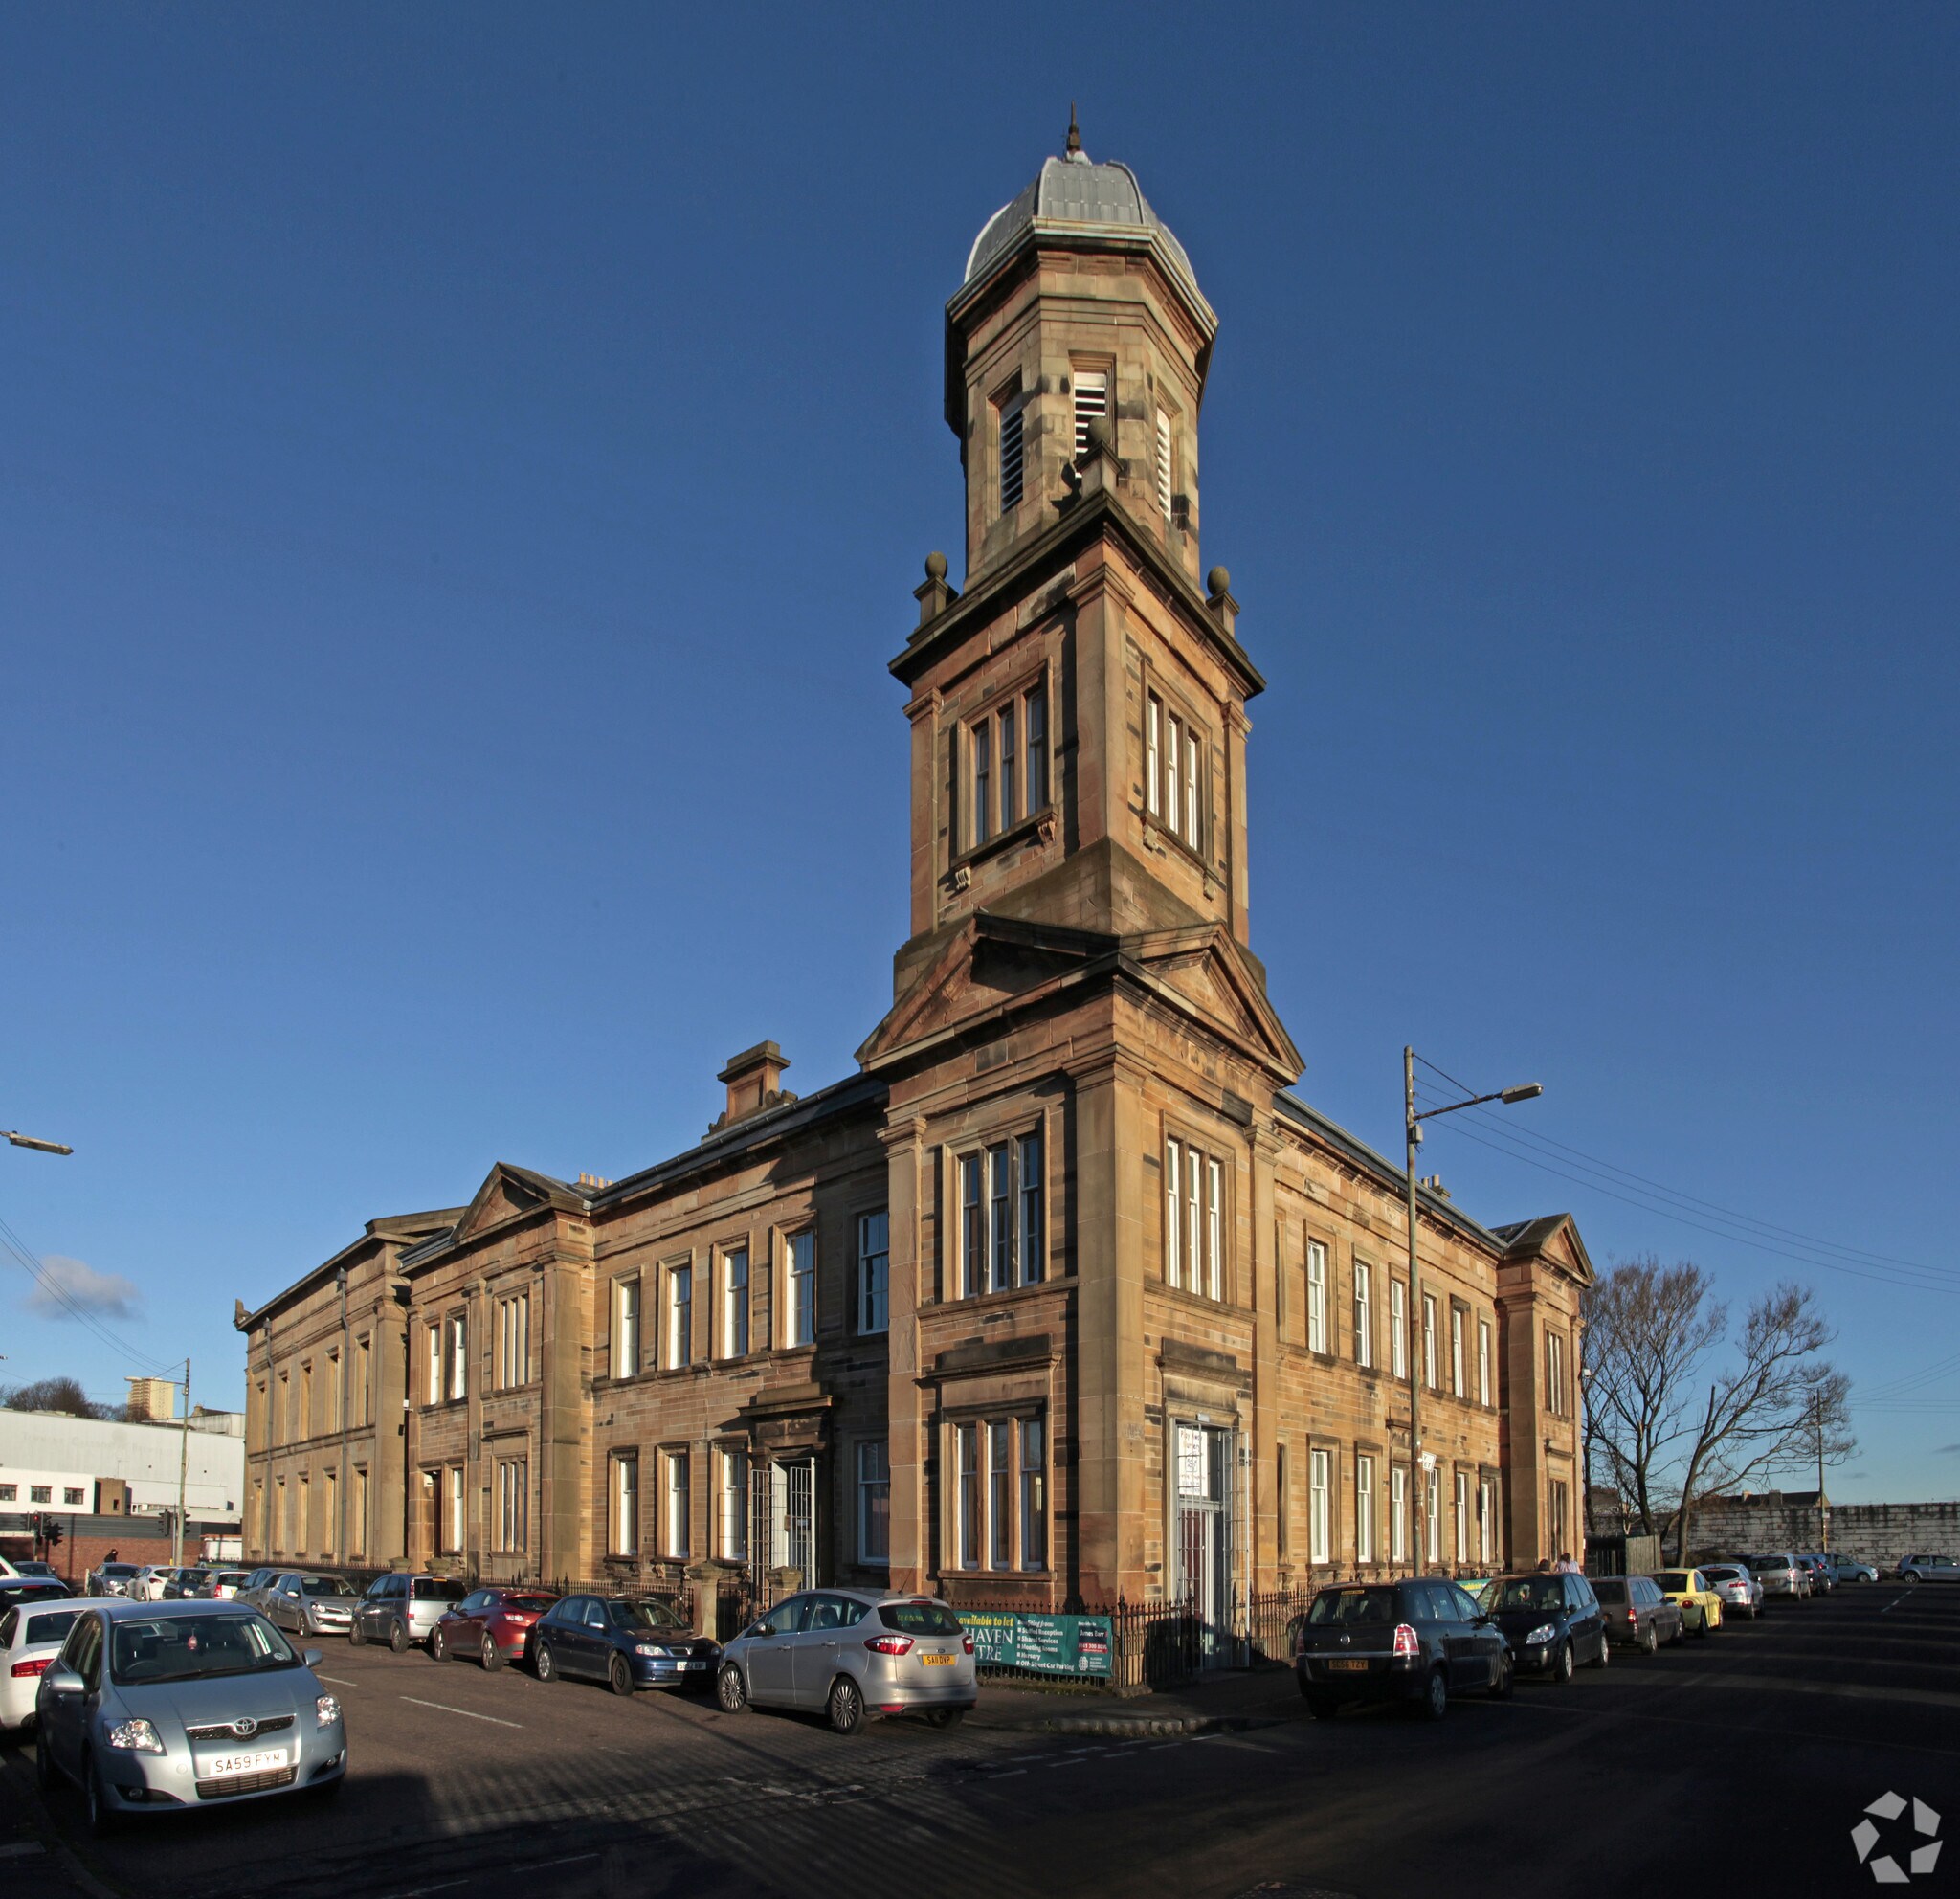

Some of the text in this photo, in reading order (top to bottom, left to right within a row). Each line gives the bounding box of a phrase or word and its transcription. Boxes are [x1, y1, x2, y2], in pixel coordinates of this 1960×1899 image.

[958, 1614, 1013, 1627] available to let
[966, 1627, 1013, 1644] HAVEN
[215, 1753, 280, 1773] SA59 FYM
